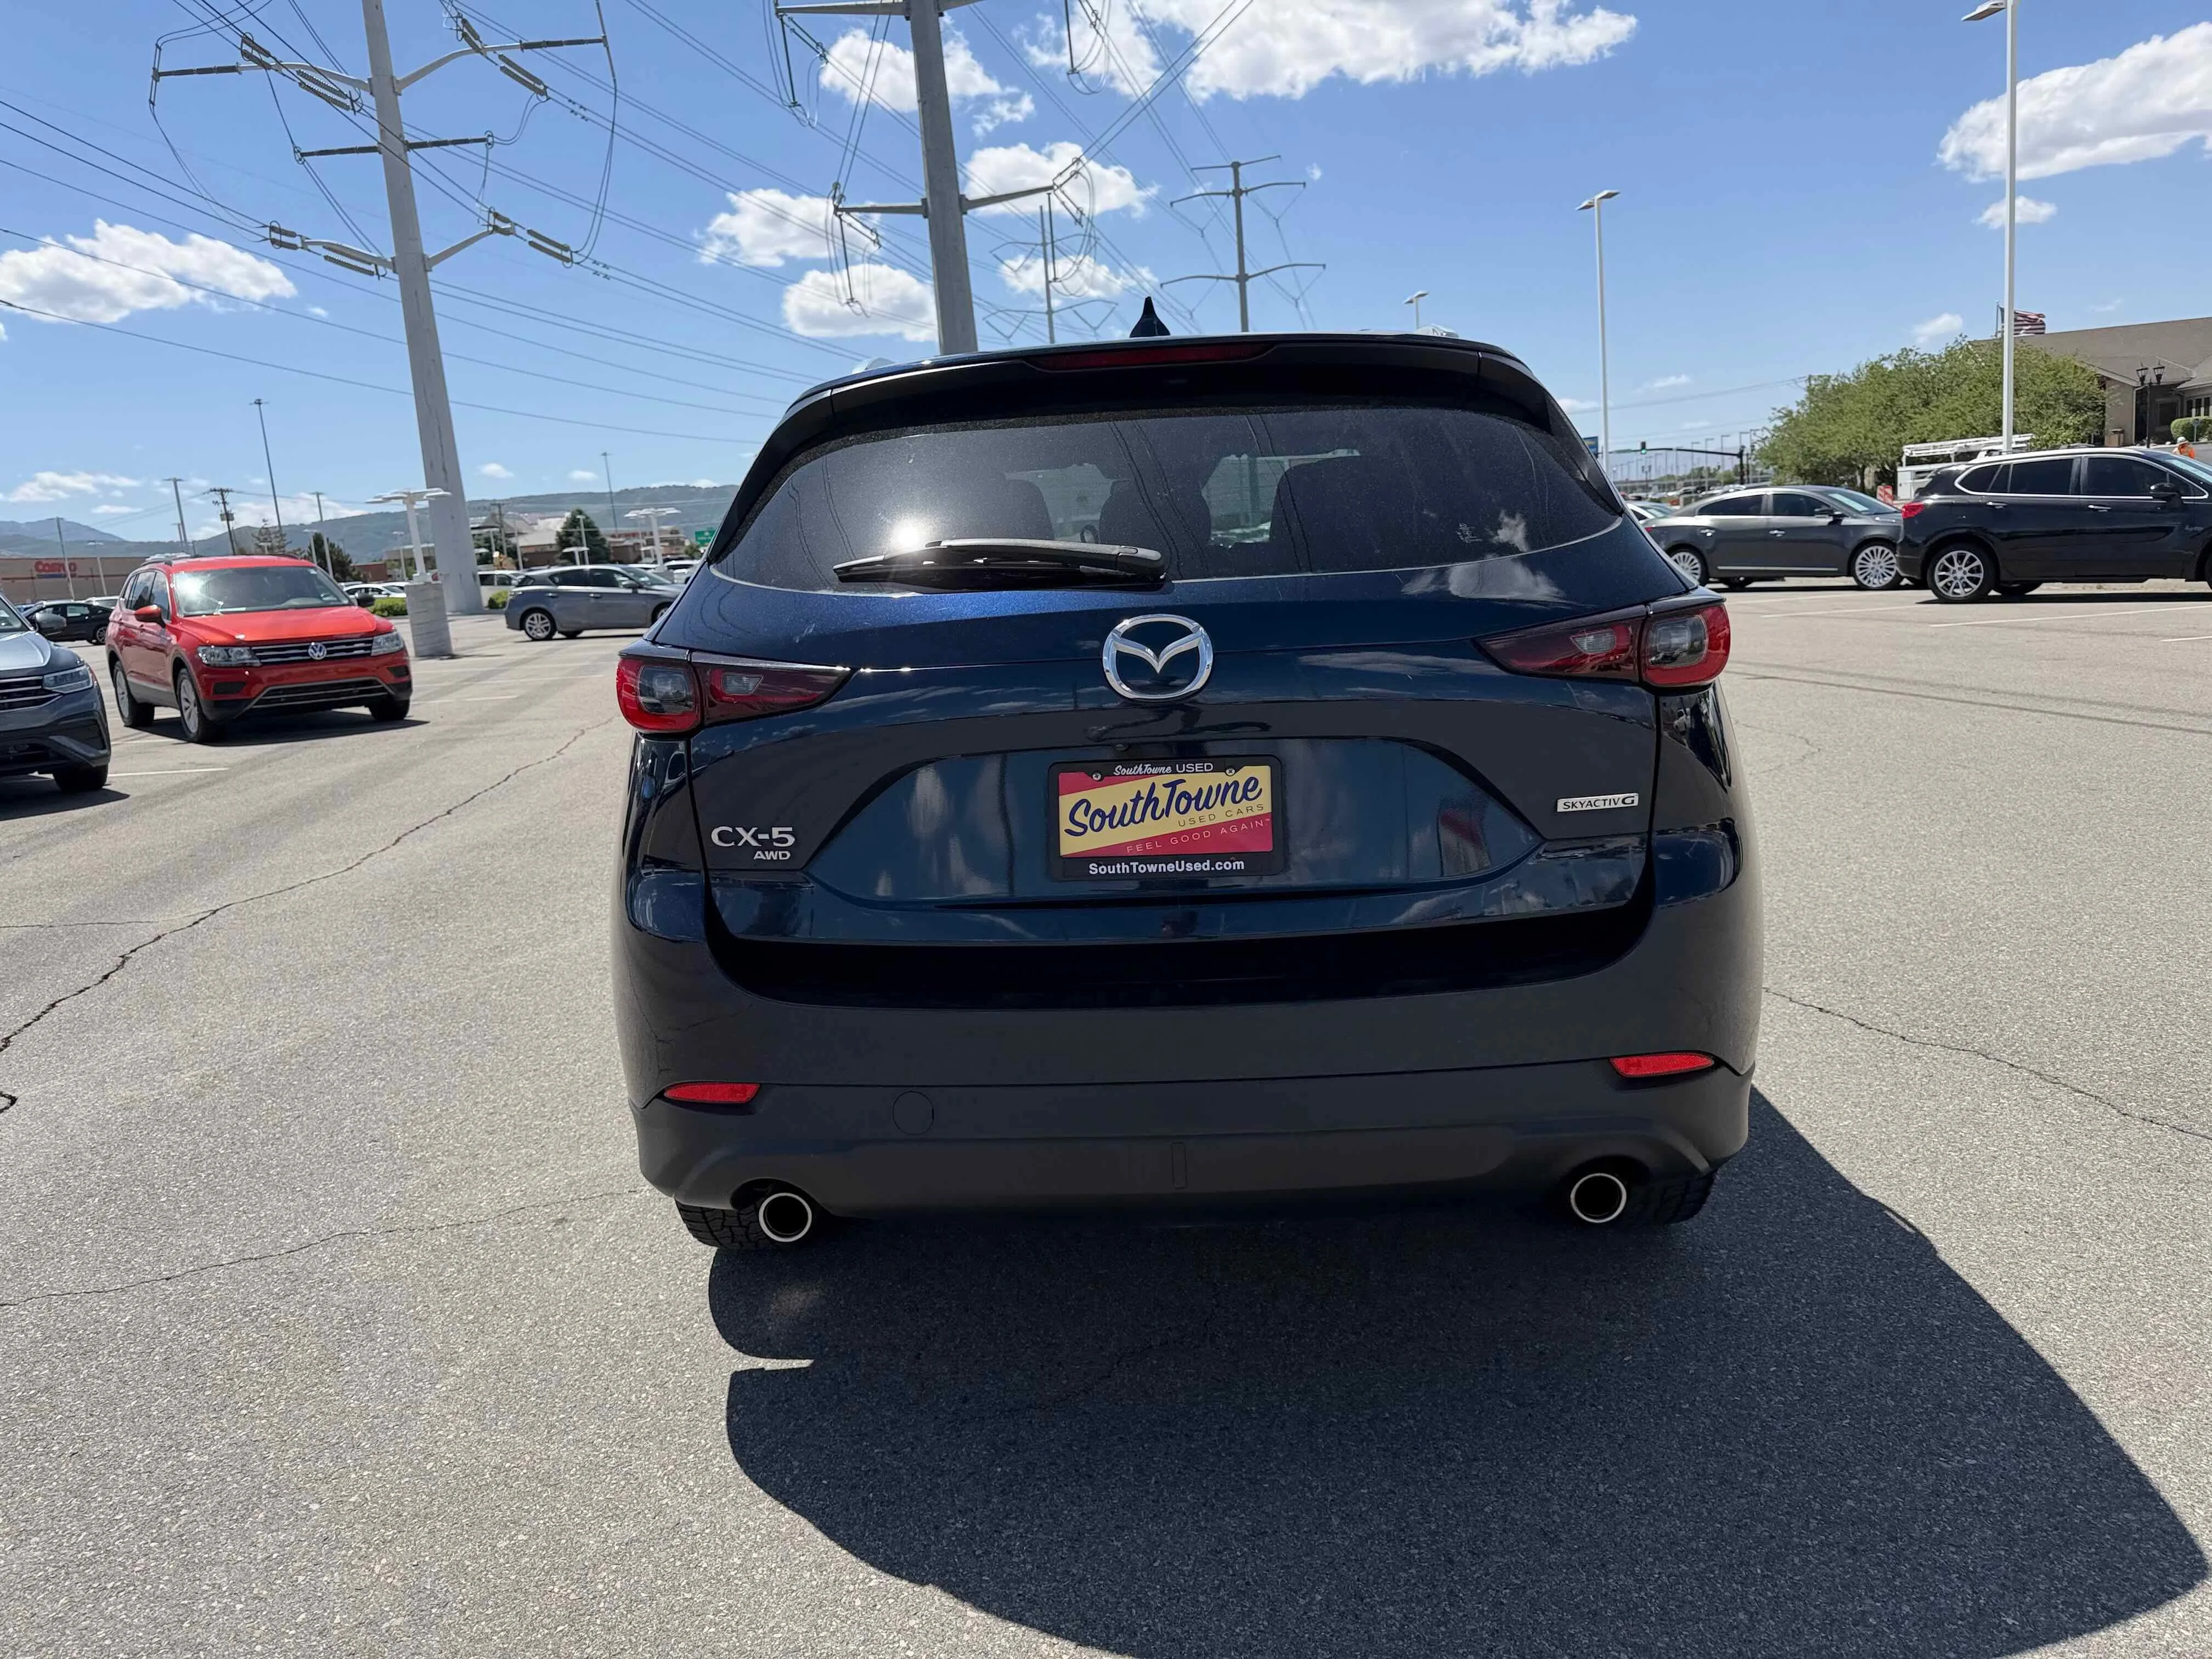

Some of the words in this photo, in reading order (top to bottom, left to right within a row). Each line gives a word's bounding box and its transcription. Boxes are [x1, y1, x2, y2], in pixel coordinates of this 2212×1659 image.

[1113, 764, 1172, 775] SouthTowne
[1176, 763, 1214, 772] USED
[1064, 776, 1262, 837] SouthTowne
[1178, 814, 1216, 827] USED
[1226, 804, 1263, 817] CARS
[710, 826, 795, 847] CX-5
[1126, 840, 1162, 854] FEEL
[1170, 830, 1211, 845] GOOD
[753, 850, 791, 860] AWD
[1088, 859, 1245, 874] SouthTowneUsed.com
